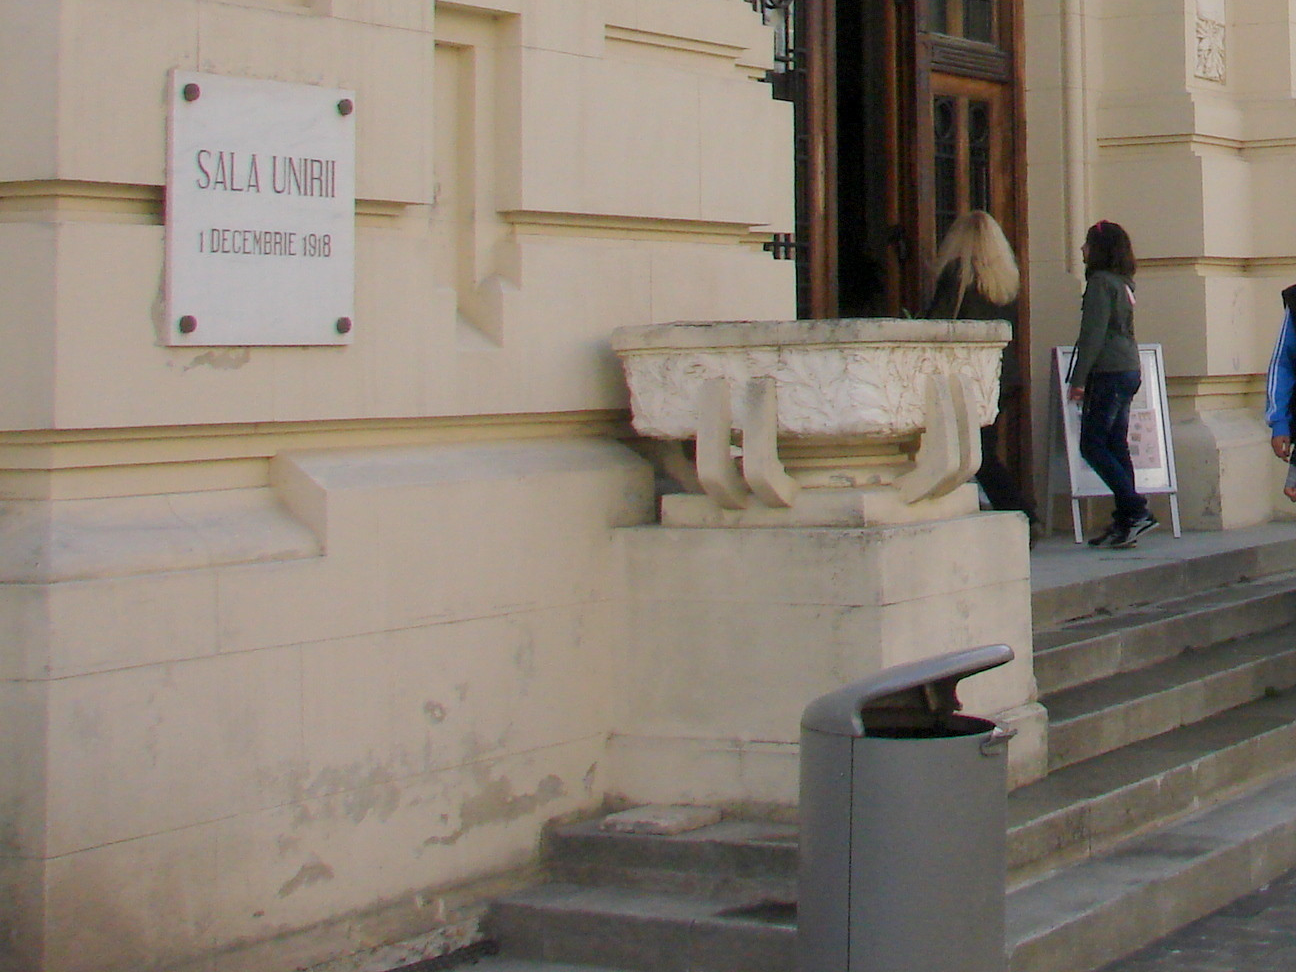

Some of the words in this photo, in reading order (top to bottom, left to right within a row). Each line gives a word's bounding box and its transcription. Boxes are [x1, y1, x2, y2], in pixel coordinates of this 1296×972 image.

[197, 149, 260, 193] SALA
[271, 155, 336, 198] UNIRII
[199, 232, 205, 253] 1
[211, 228, 297, 256] DECEMBRIE
[303, 233, 332, 257] 1918
